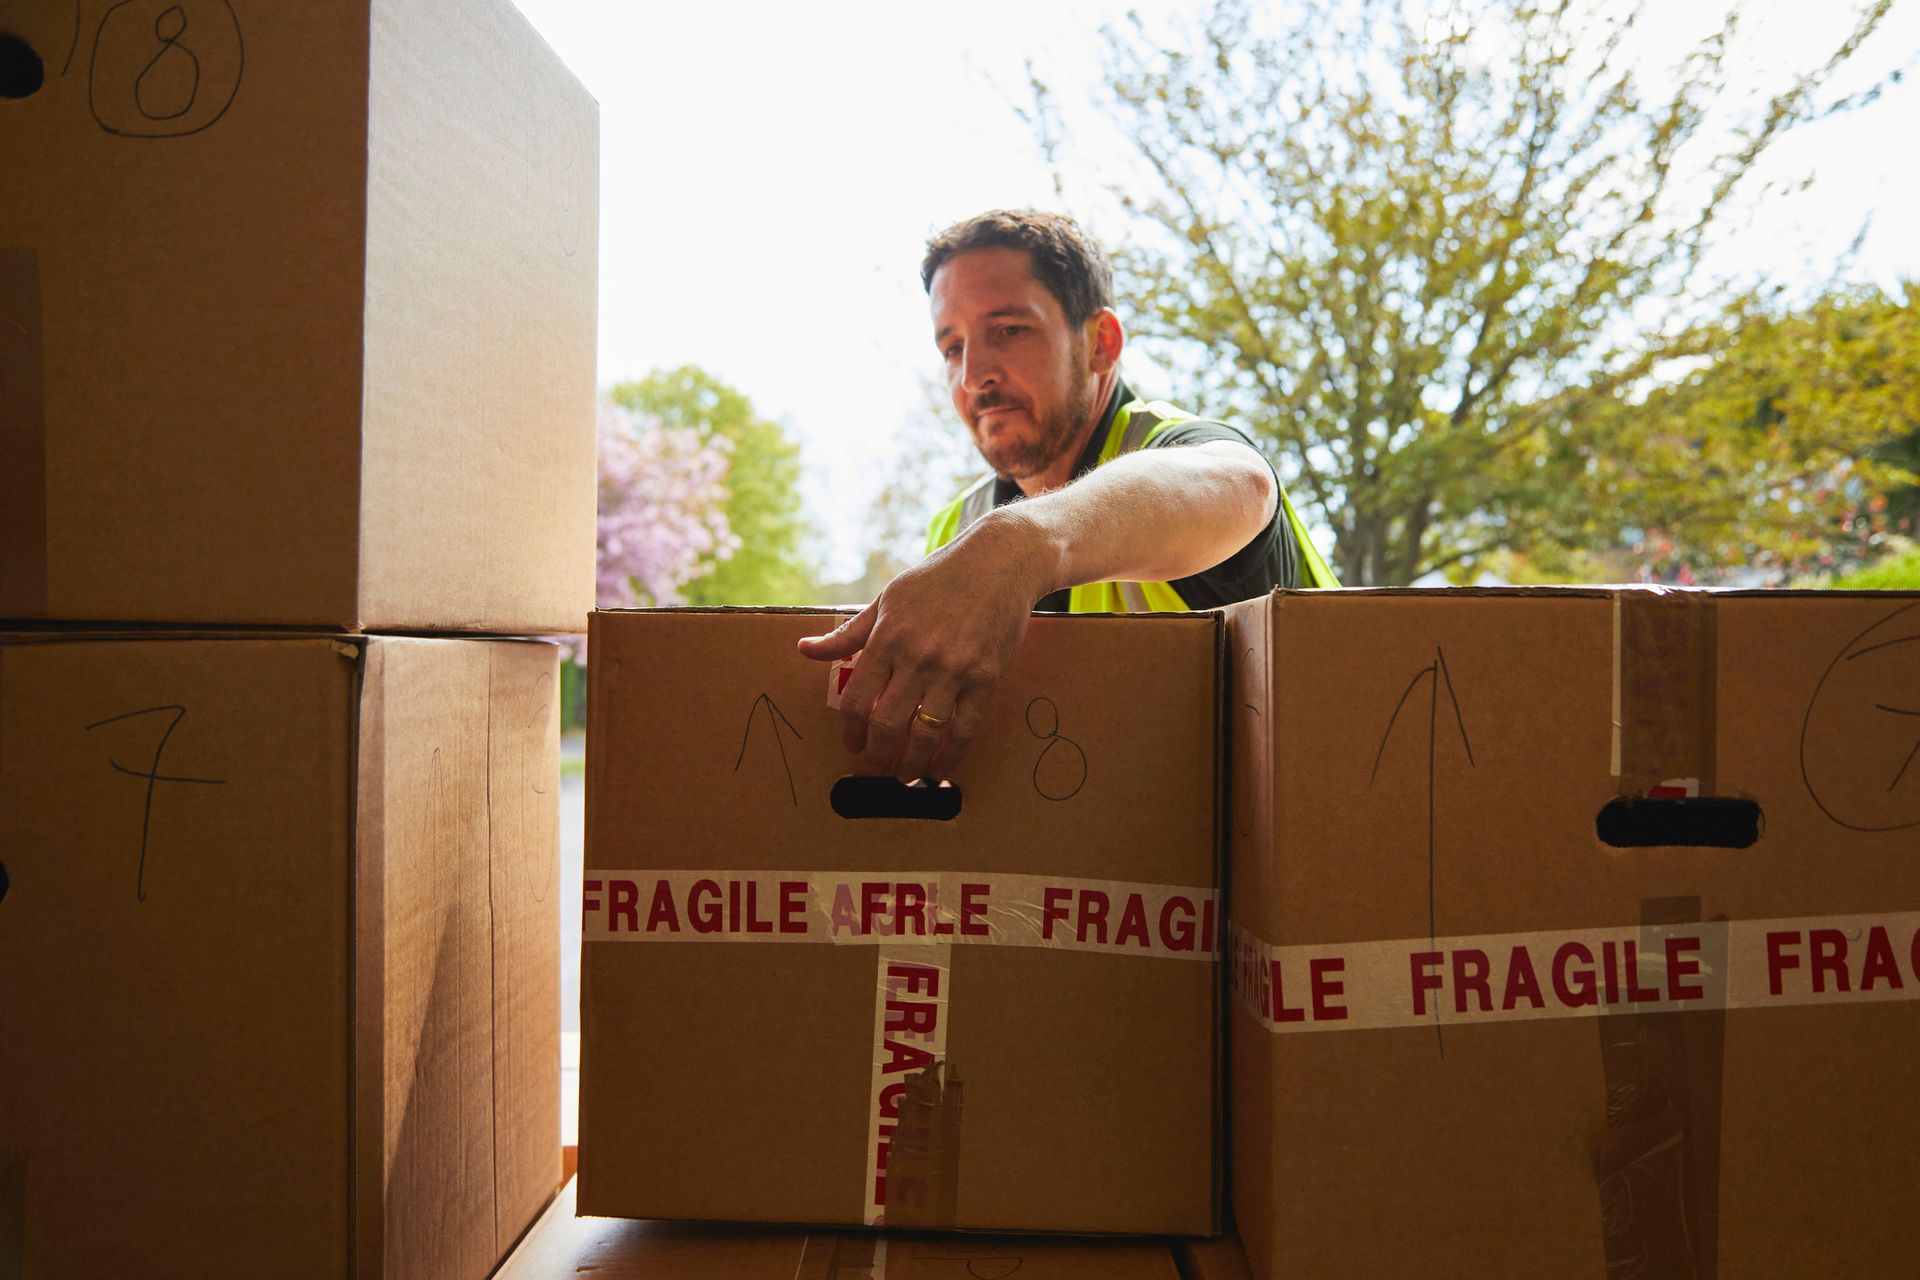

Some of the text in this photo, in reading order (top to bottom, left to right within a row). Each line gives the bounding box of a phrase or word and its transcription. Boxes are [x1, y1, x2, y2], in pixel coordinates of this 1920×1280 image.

[136, 5, 200, 121] 8
[1025, 696, 1088, 801] 8
[85, 704, 228, 902] 7
[582, 878, 809, 934] FRAGILE
[1042, 887, 1221, 953] FRAGI
[1410, 937, 1704, 1016] FRAGILE
[1766, 926, 1920, 996] FRA
